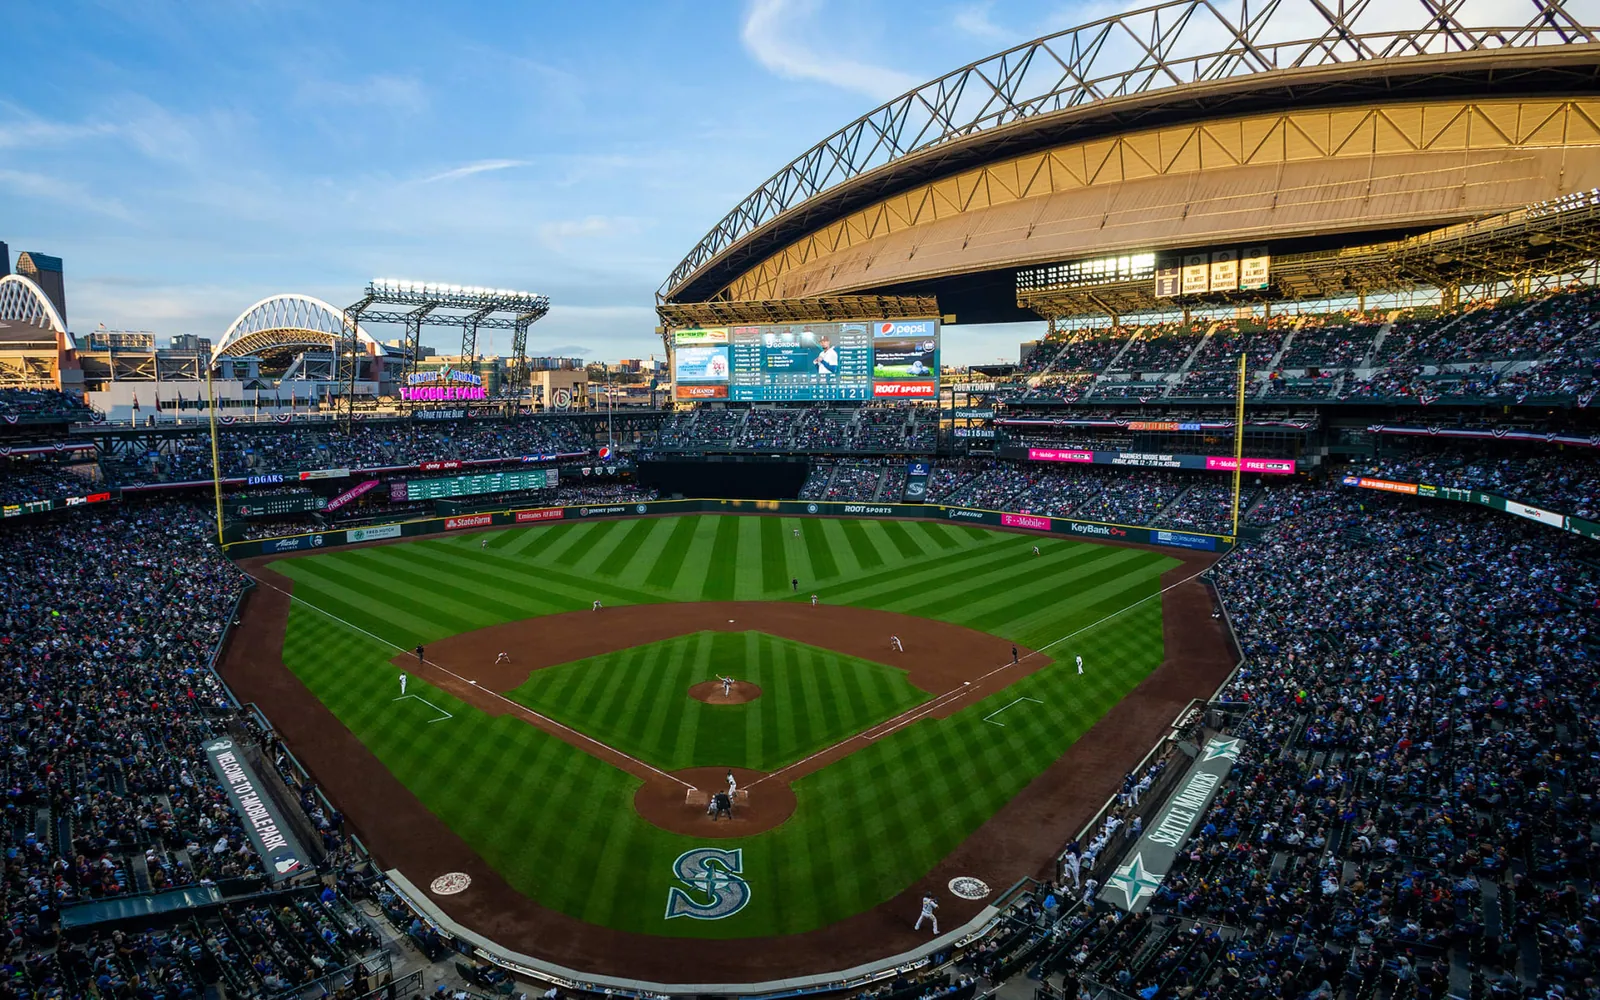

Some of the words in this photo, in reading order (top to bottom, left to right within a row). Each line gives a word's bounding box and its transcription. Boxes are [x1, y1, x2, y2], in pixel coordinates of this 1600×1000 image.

[897, 324, 926, 334] pepsi
[408, 371, 438, 385] SEATTLE
[953, 383, 996, 391] COUNTDOWN
[399, 387, 454, 401] T-MOBILE
[456, 387, 486, 399] PARK
[248, 475, 283, 485] EDGARS
[66, 497, 79, 506] 710
[328, 501, 340, 510] THE
[340, 492, 352, 503] PEN
[1072, 523, 1110, 535] KeyBank
[1180, 534, 1206, 544] Insurance
[216, 751, 248, 785] WELCOME
[233, 781, 253, 794] TO
[238, 791, 274, 832] T-MOBILE
[1148, 806, 1196, 848] SEATTLE
[1172, 771, 1219, 811] MARINERS
[259, 824, 288, 852] PARK
